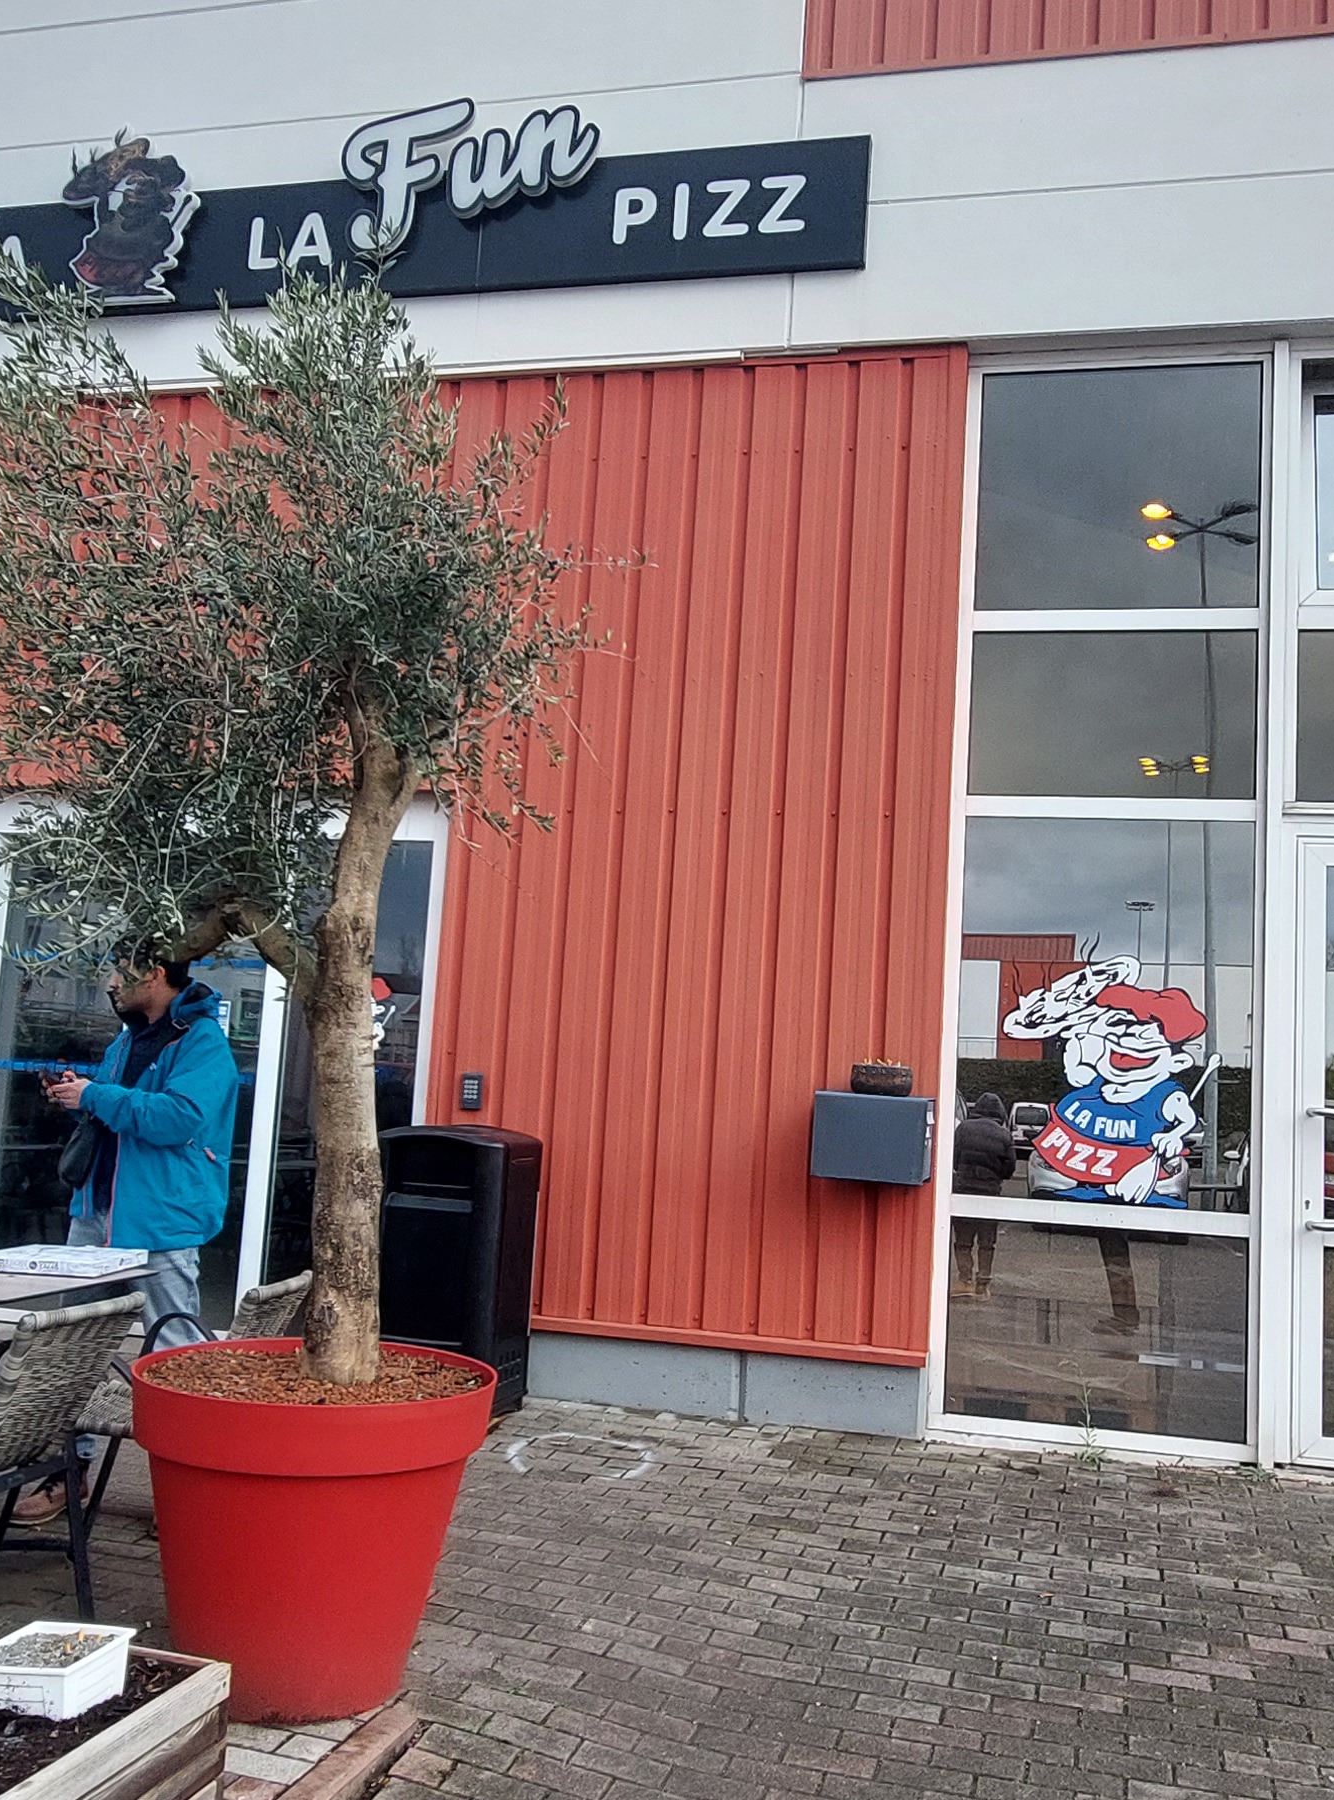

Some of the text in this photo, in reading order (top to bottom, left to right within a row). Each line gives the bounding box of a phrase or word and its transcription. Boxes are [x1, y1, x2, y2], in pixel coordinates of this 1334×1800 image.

[247, 211, 333, 270] LA
[341, 97, 600, 256] Fun
[612, 174, 807, 245] PIZZ
[1063, 1100, 1137, 1140] LA FUN
[1040, 1126, 1119, 1177] PIZZ
